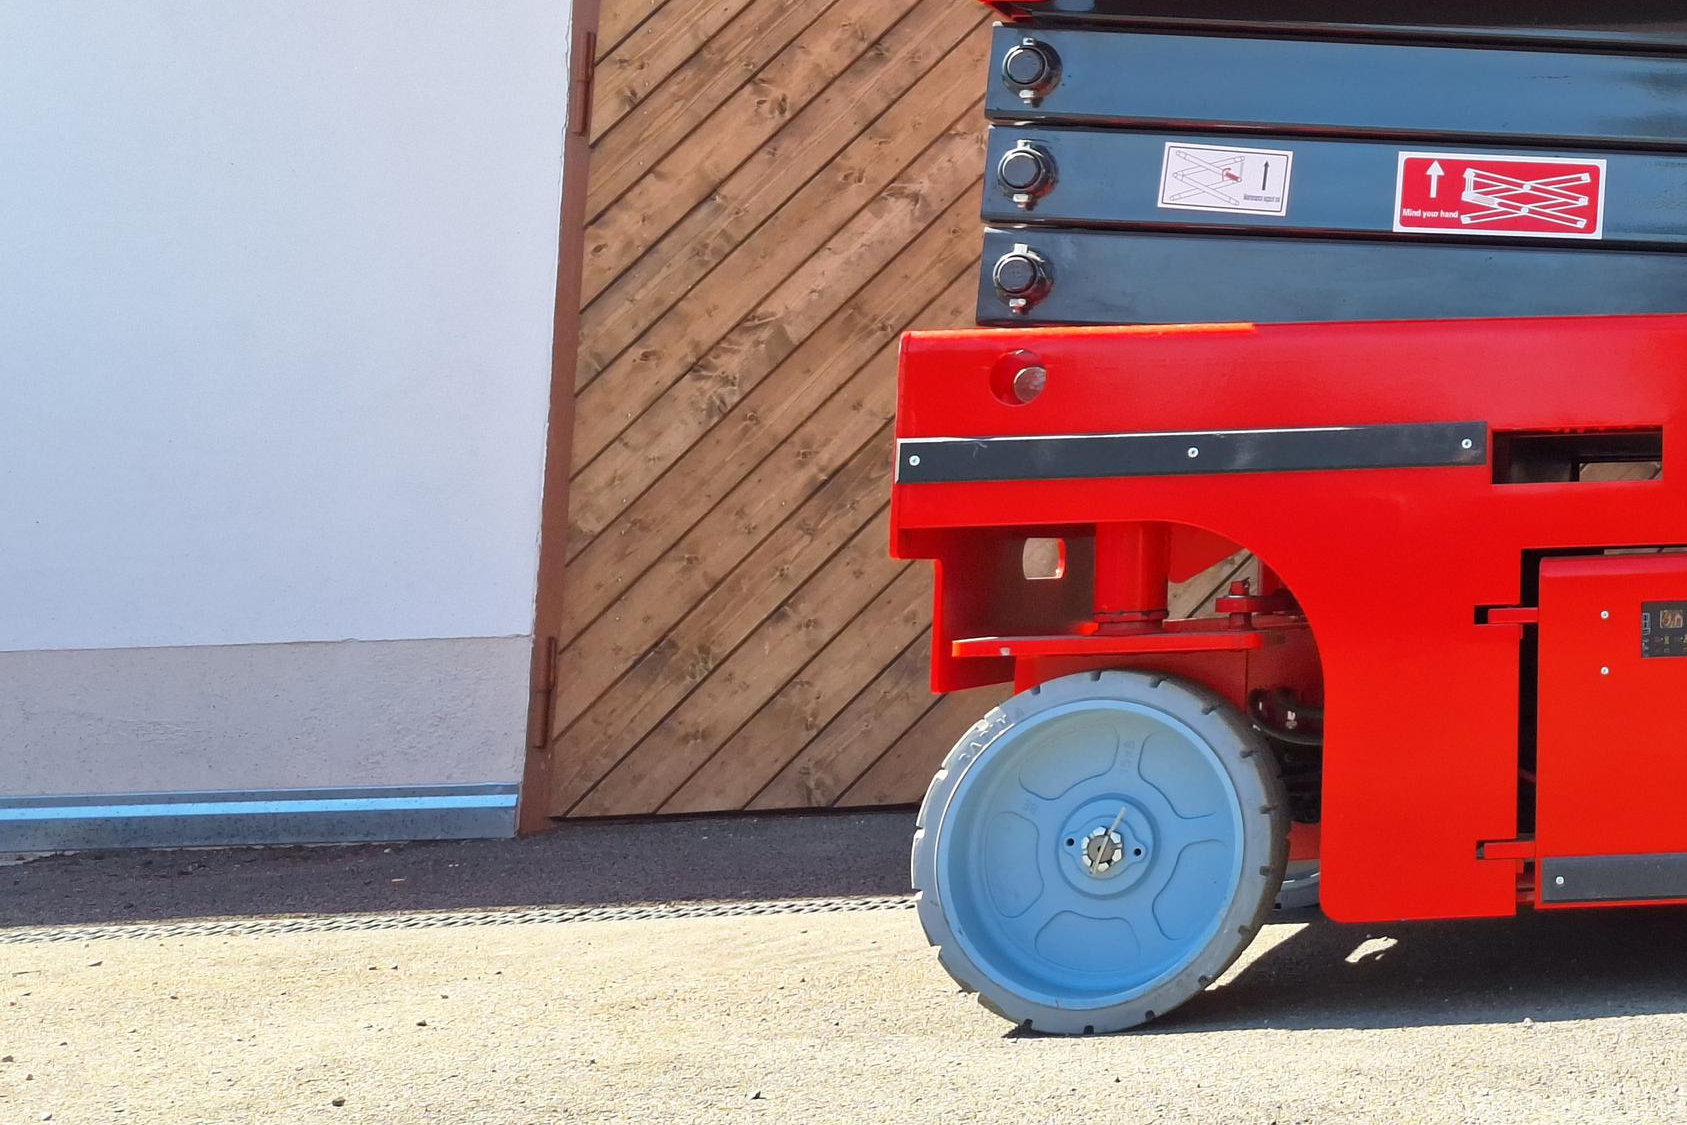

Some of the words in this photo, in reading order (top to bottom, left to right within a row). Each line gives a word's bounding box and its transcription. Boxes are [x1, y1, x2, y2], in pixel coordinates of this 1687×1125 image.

[1402, 208, 1421, 217] Mind
[1423, 210, 1439, 218] your
[1440, 210, 1459, 218] hand
